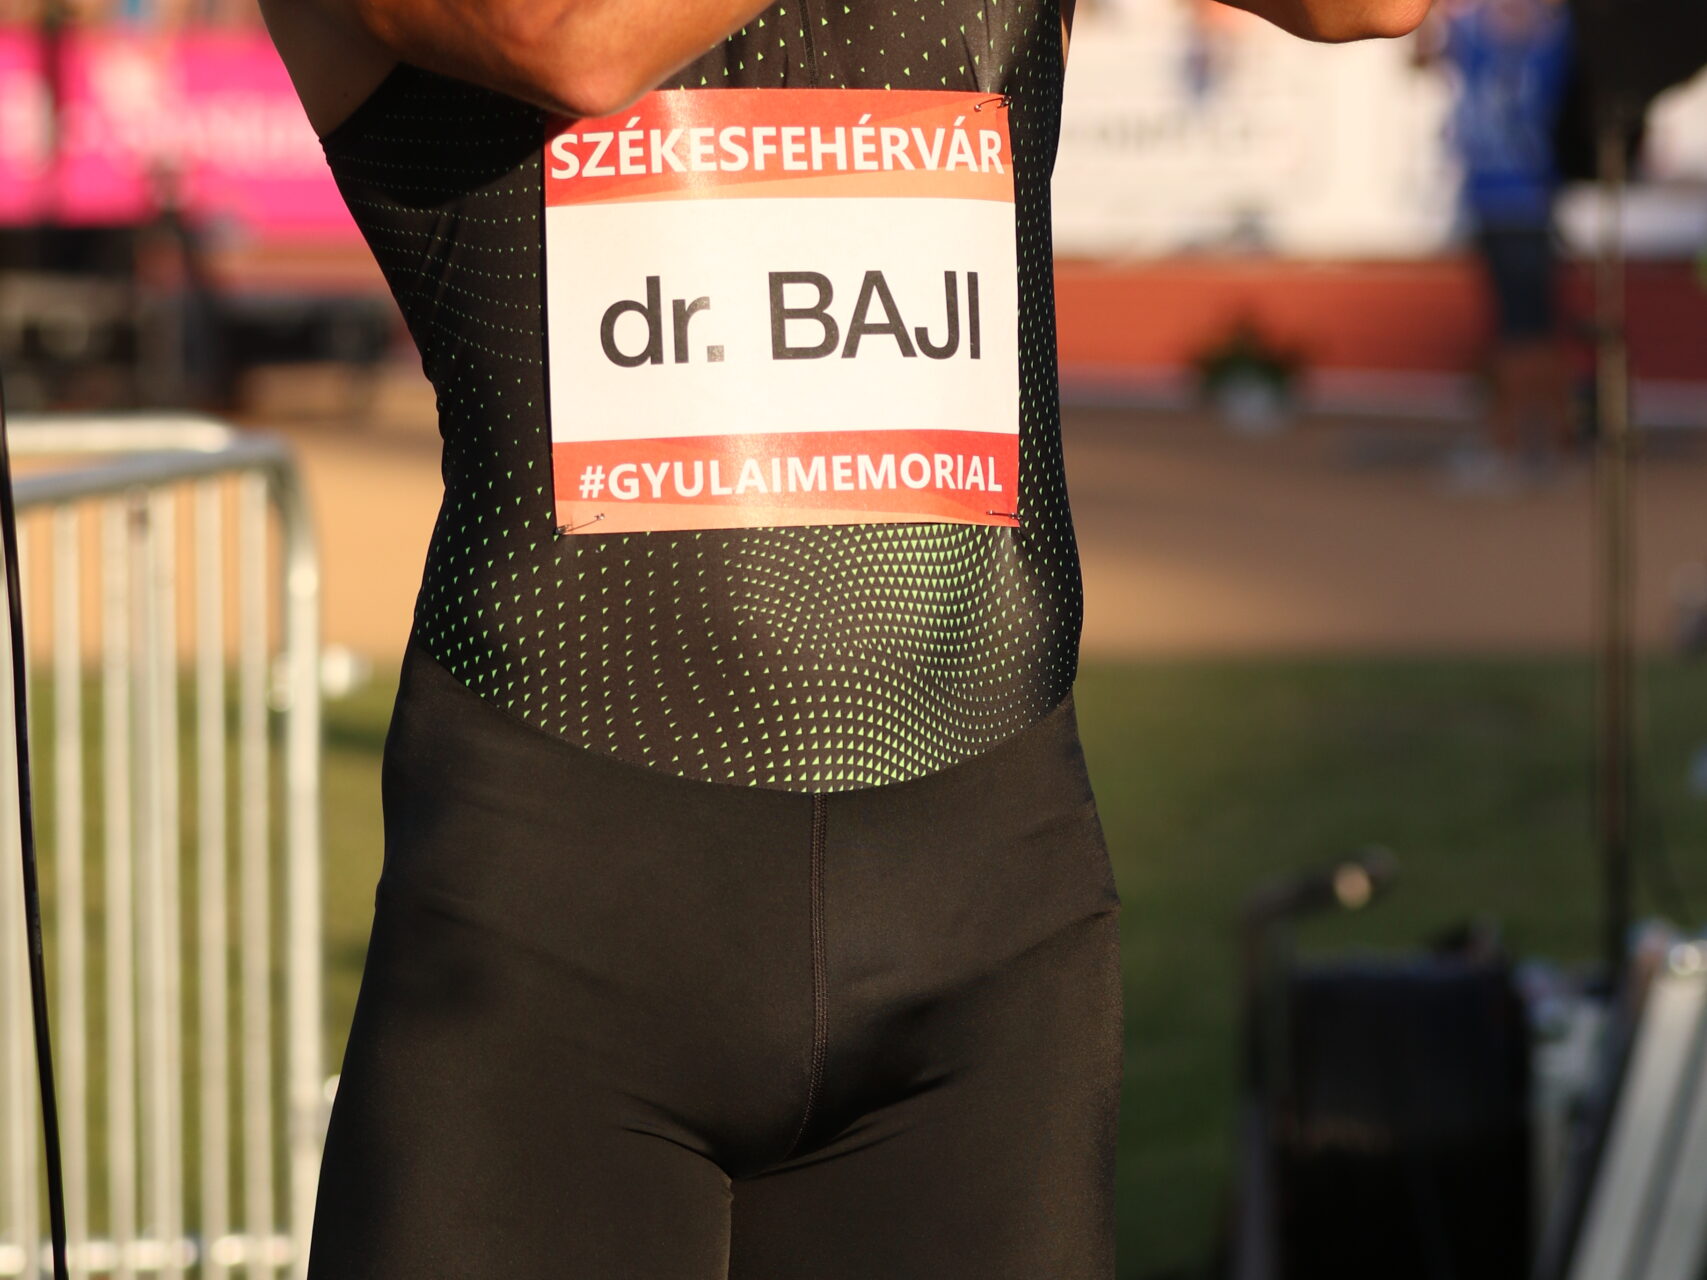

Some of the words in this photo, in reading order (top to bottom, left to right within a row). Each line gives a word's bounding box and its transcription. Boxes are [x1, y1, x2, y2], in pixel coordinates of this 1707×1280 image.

[551, 114, 1005, 180] SZÉKESFEHÉRVÁR
[600, 275, 725, 368] dr.
[768, 270, 981, 360] BAJI
[579, 453, 1002, 501] #GYULAIMEMORIAL
